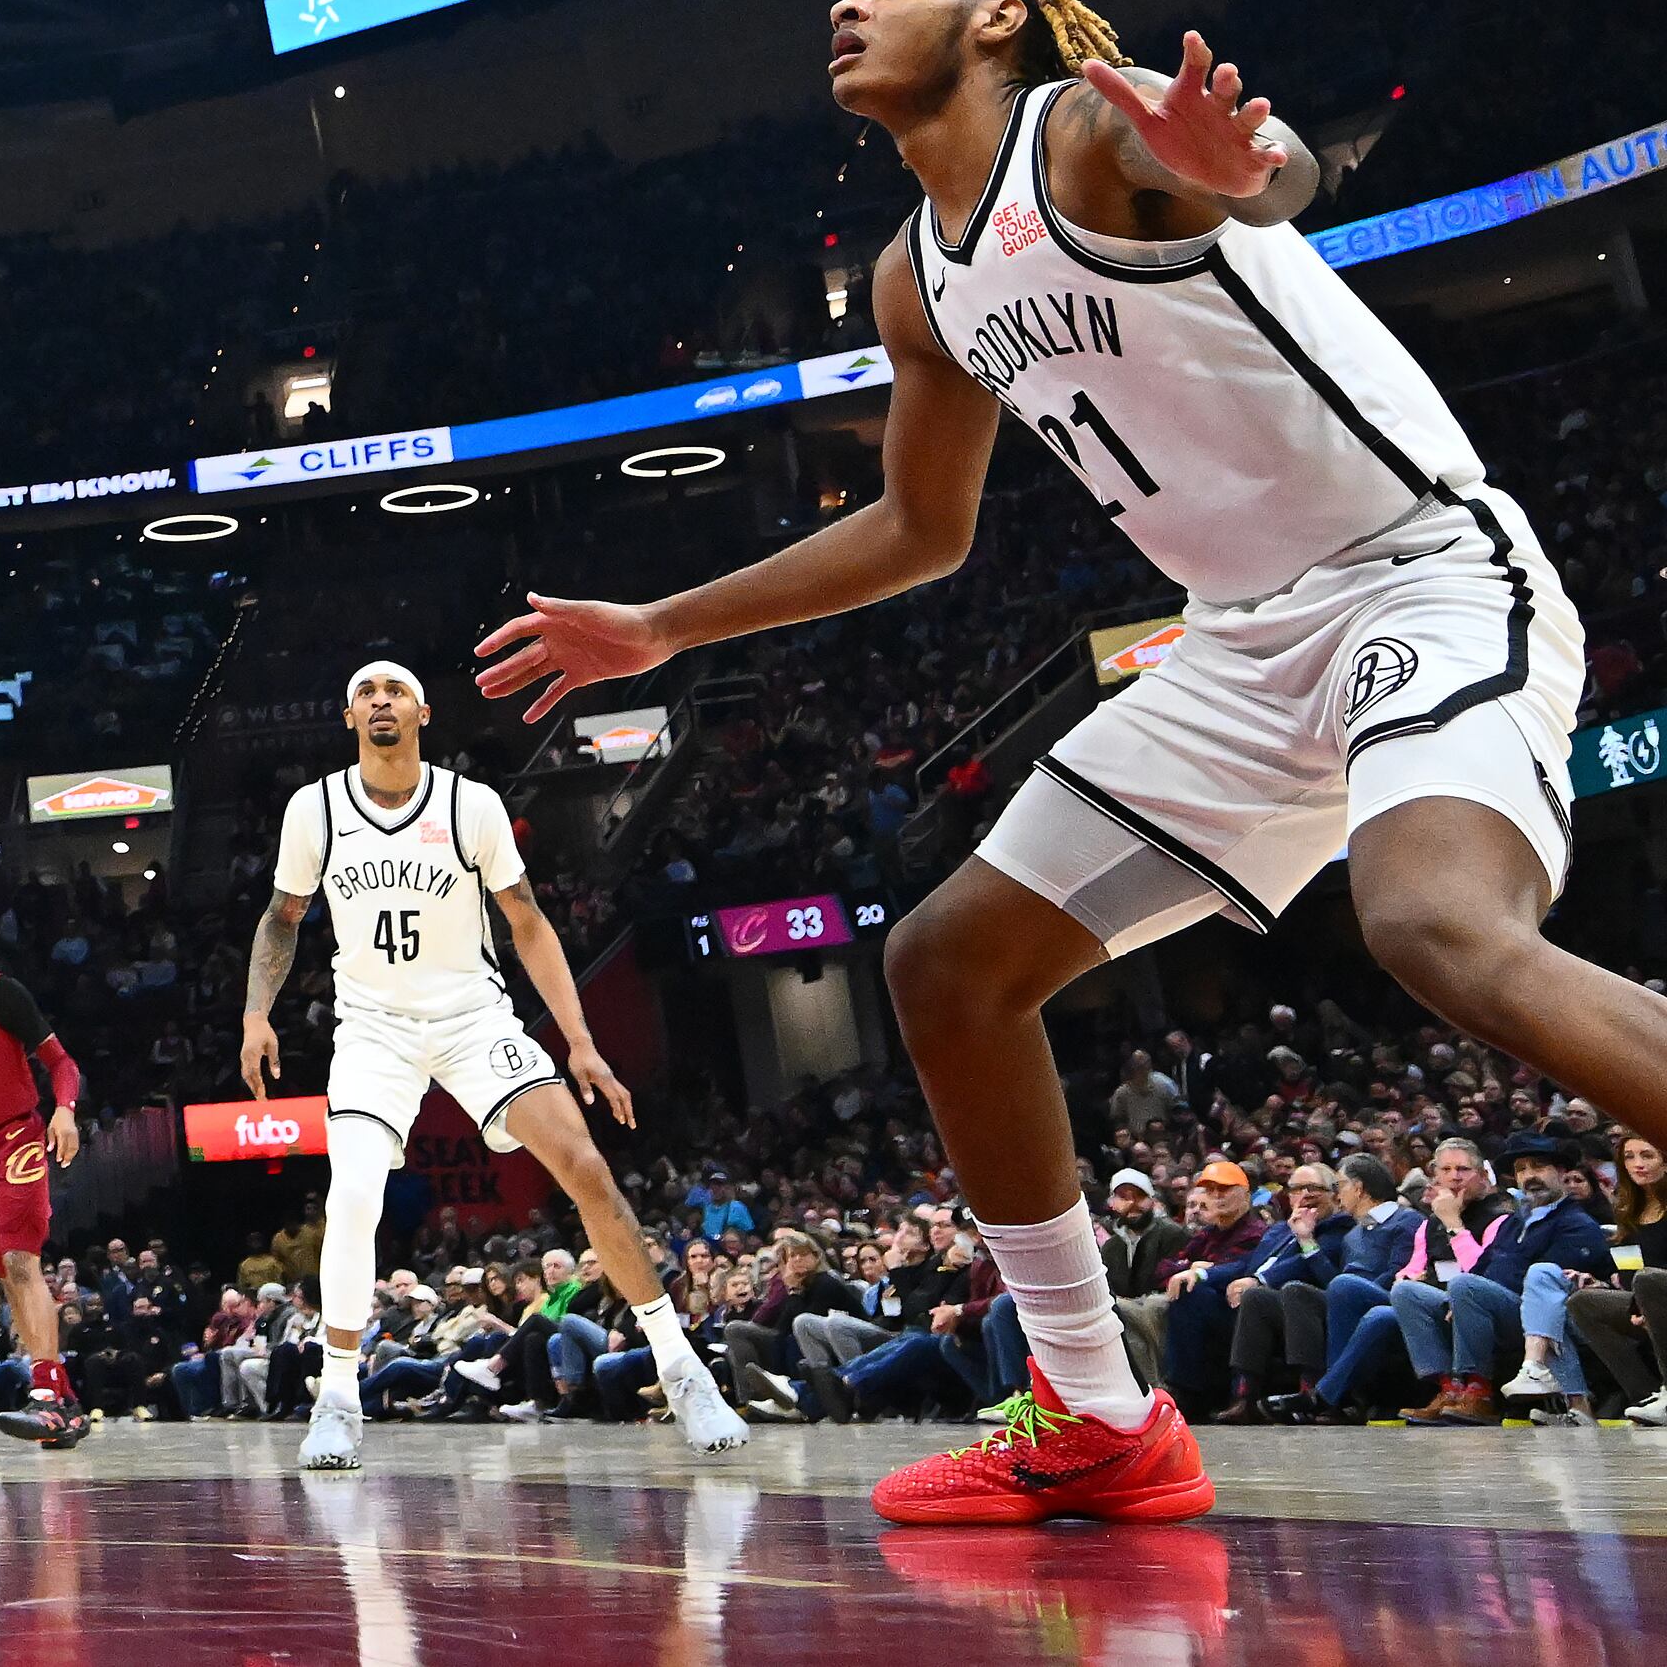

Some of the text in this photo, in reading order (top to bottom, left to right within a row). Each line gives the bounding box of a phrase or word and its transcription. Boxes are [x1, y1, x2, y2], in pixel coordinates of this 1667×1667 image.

[992, 202, 1020, 227] GET
[1318, 182, 1508, 264] ECISION
[1581, 131, 1667, 189] AUT
[995, 209, 1040, 241] YOUR
[1002, 222, 1047, 258] GUIDE
[968, 292, 1123, 415] BROOKLYN
[299, 435, 435, 476] CLIFFS
[1037, 389, 1161, 520] 21
[75, 468, 176, 500] KNOW.
[247, 699, 335, 724] WESTF
[62, 789, 139, 810] SERVPRO
[331, 860, 458, 900] BROOKLYN
[374, 910, 420, 965] 45
[698, 904, 885, 956] 1 33 20
[504, 1043, 523, 1072] B
[235, 1114, 300, 1146] fubo
